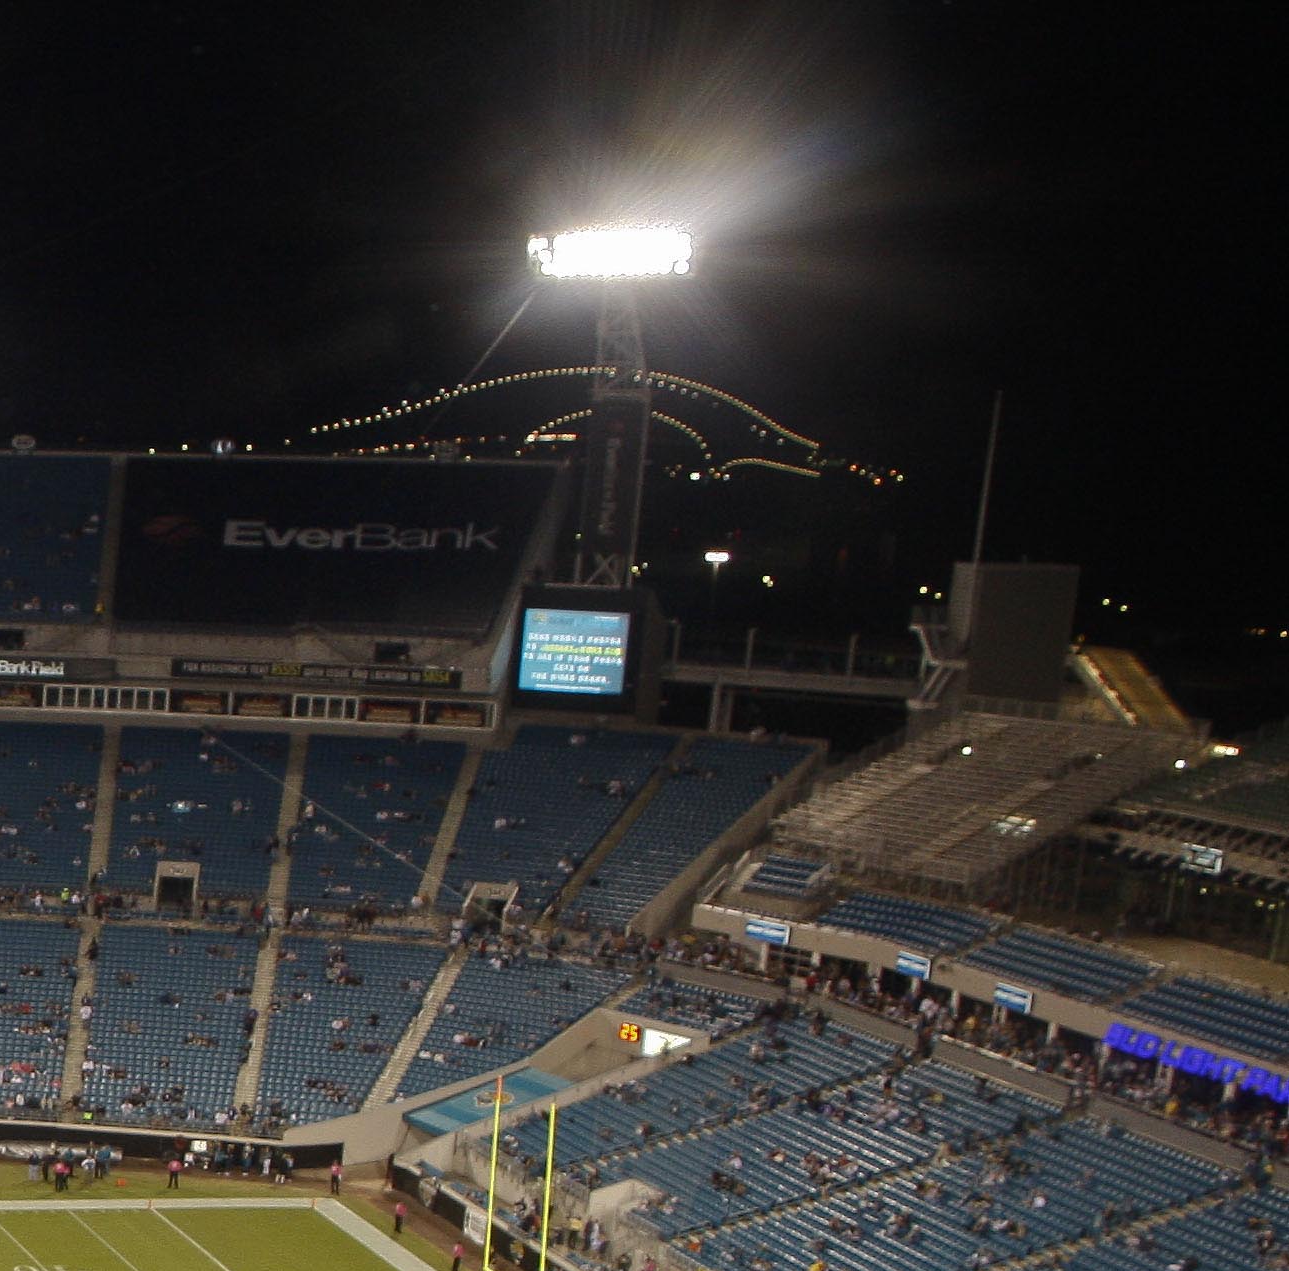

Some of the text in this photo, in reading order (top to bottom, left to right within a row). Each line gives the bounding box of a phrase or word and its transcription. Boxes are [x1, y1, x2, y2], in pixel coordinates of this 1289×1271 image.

[223, 520, 498, 550] EverBank
[31, 661, 65, 676] Field
[1102, 1023, 1162, 1059] BUD
[1159, 1040, 1248, 1085] LIGHT
